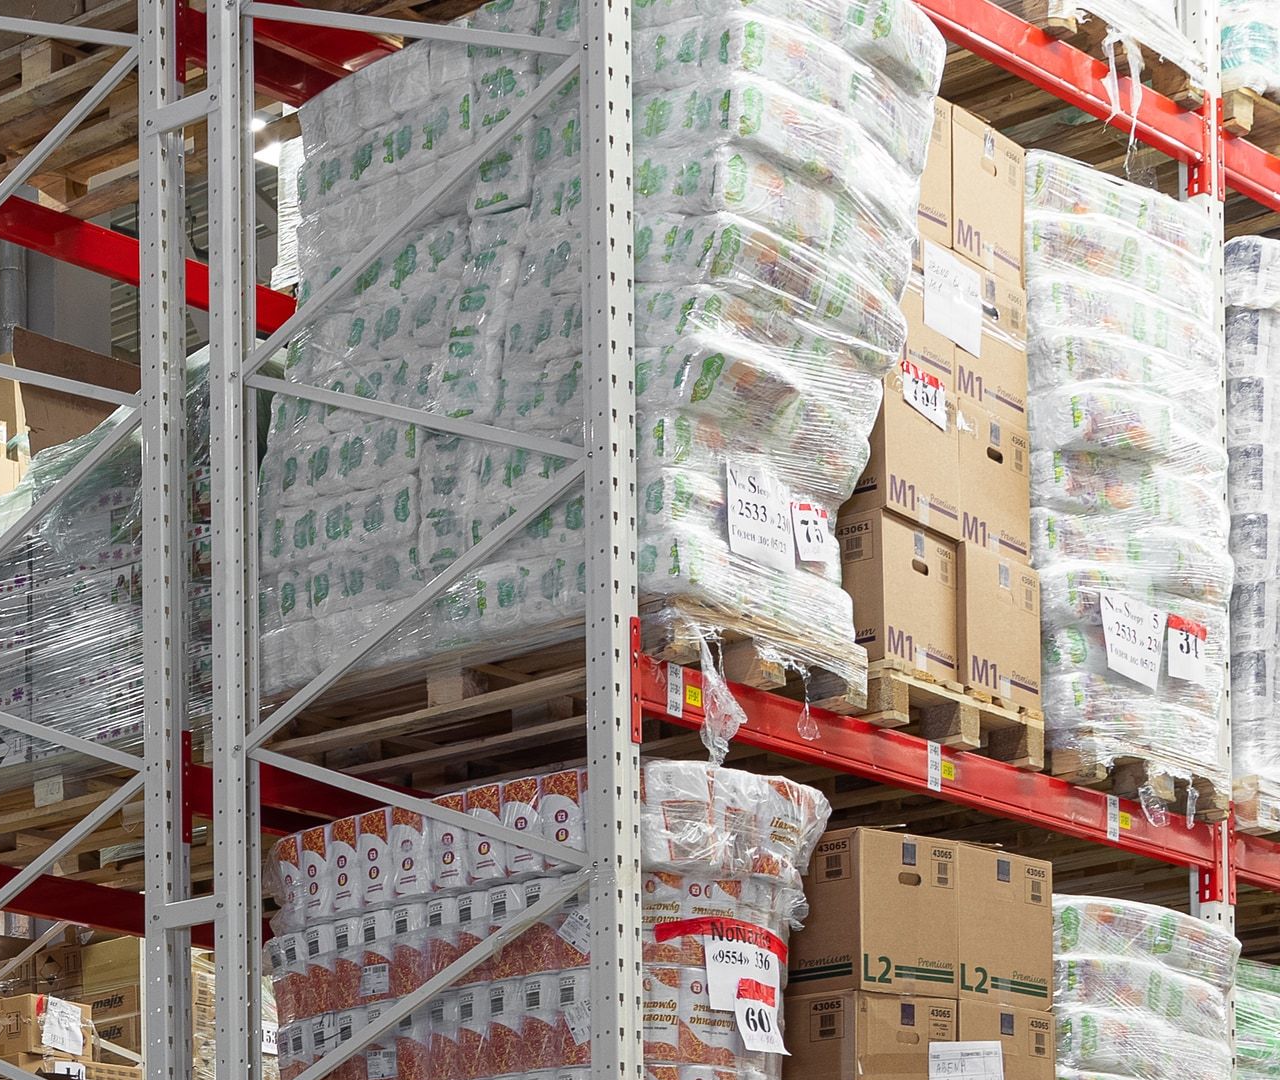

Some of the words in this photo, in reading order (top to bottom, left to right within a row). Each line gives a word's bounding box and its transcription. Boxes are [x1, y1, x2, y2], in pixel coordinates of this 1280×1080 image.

[957, 218, 982, 257] M1
[957, 365, 983, 402] M1
[1011, 435, 1026, 450] 43061
[889, 473, 916, 511] M1
[929, 493, 958, 513] Premium
[800, 519, 824, 545] 75
[962, 511, 987, 547] M1
[1000, 530, 1027, 549] Premium
[888, 625, 913, 662] M1
[927, 643, 955, 663] Premium
[971, 655, 997, 690] M1
[1011, 670, 1039, 689] Premium
[932, 849, 953, 859] 43065
[1026, 867, 1046, 878] 43065
[712, 949, 749, 966] «9554»
[798, 953, 852, 968] Premium
[917, 957, 954, 970] Premium
[863, 953, 892, 984] L2
[1012, 970, 1048, 985] Premium
[960, 963, 988, 994] L2
[92, 993, 124, 1010] majix
[812, 1000, 842, 1011] 43065
[745, 1007, 771, 1033] 60
[930, 1009, 952, 1019] 43065
[1030, 1019, 1049, 1030] 43065
